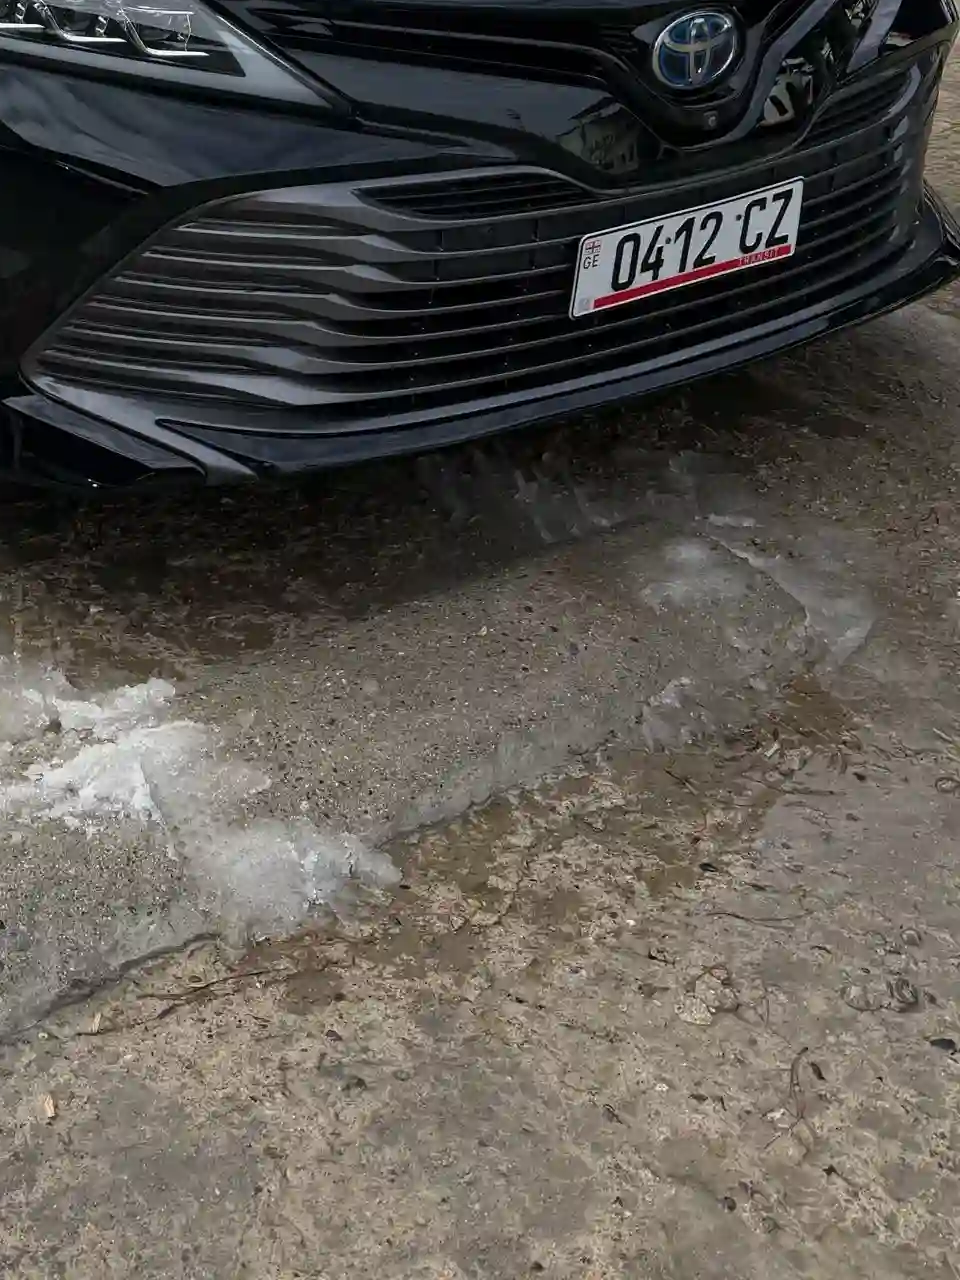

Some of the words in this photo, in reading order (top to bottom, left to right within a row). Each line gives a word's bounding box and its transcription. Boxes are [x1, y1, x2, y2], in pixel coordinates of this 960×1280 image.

[583, 253, 600, 270] GE
[610, 211, 724, 293] 0412
[739, 188, 794, 254] CZ
